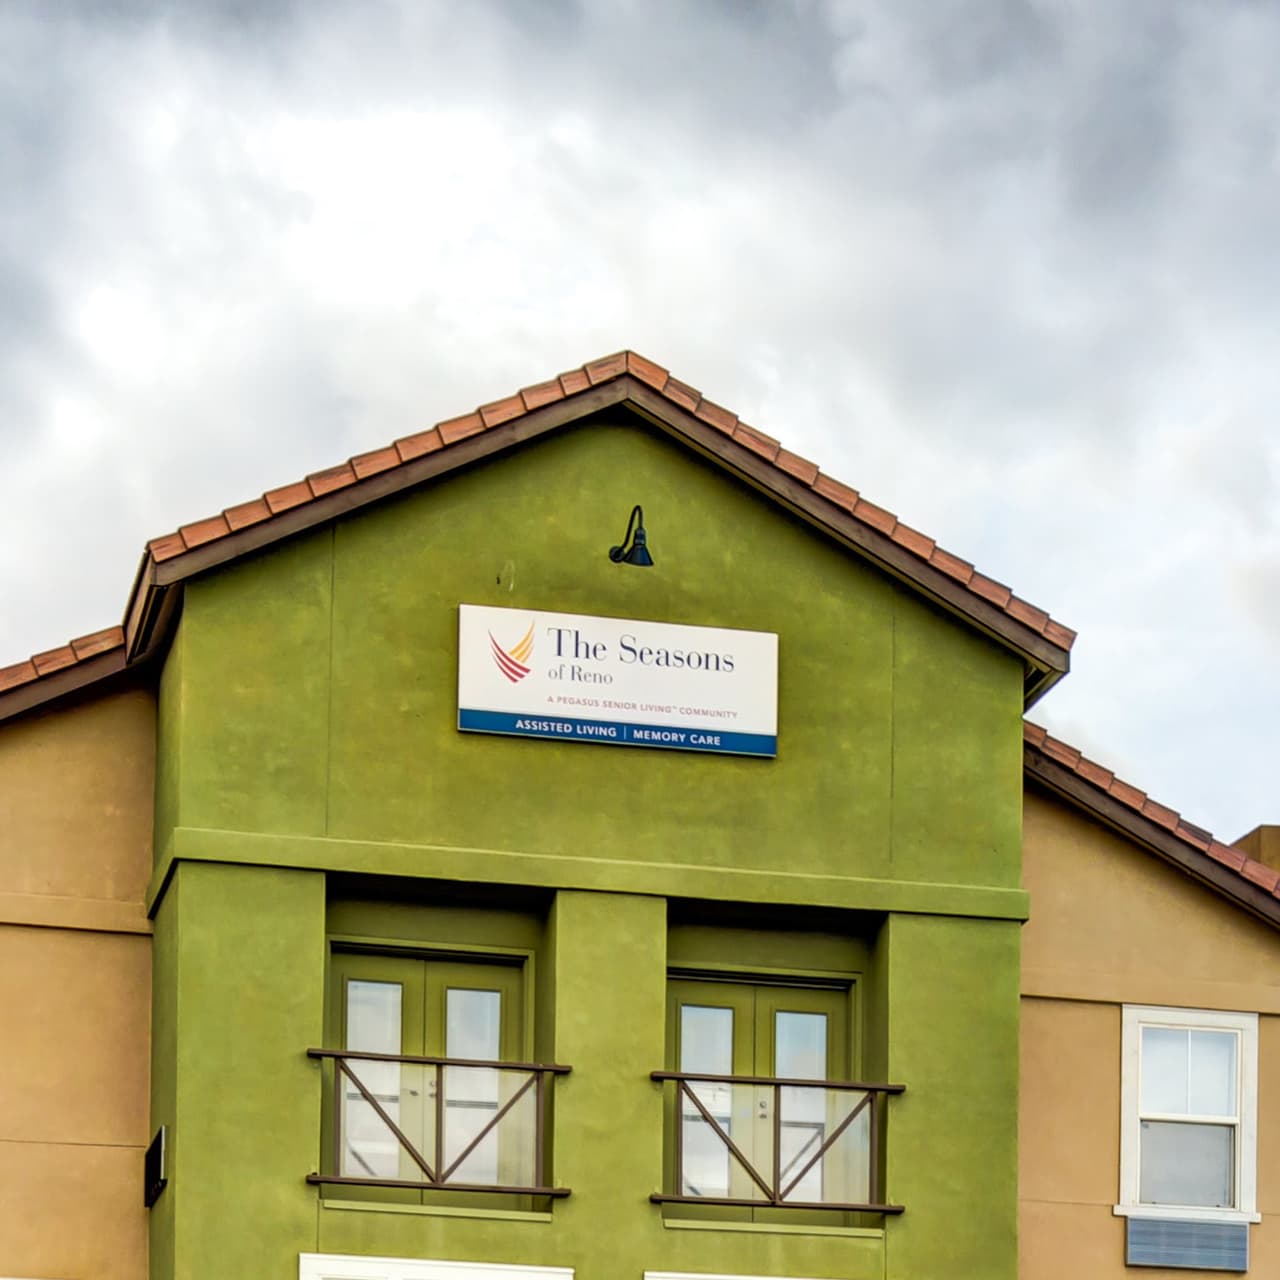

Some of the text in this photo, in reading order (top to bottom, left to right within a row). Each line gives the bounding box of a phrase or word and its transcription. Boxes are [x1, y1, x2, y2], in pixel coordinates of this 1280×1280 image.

[547, 627, 735, 673] The Seasons
[548, 664, 613, 685] of Reno
[557, 696, 600, 707] PEGASUS
[602, 700, 638, 710] SENIOR
[679, 707, 738, 719] COMMUNITY
[516, 719, 617, 737] ASSISTED LIVING
[633, 729, 721, 746] MEMORY CARE
